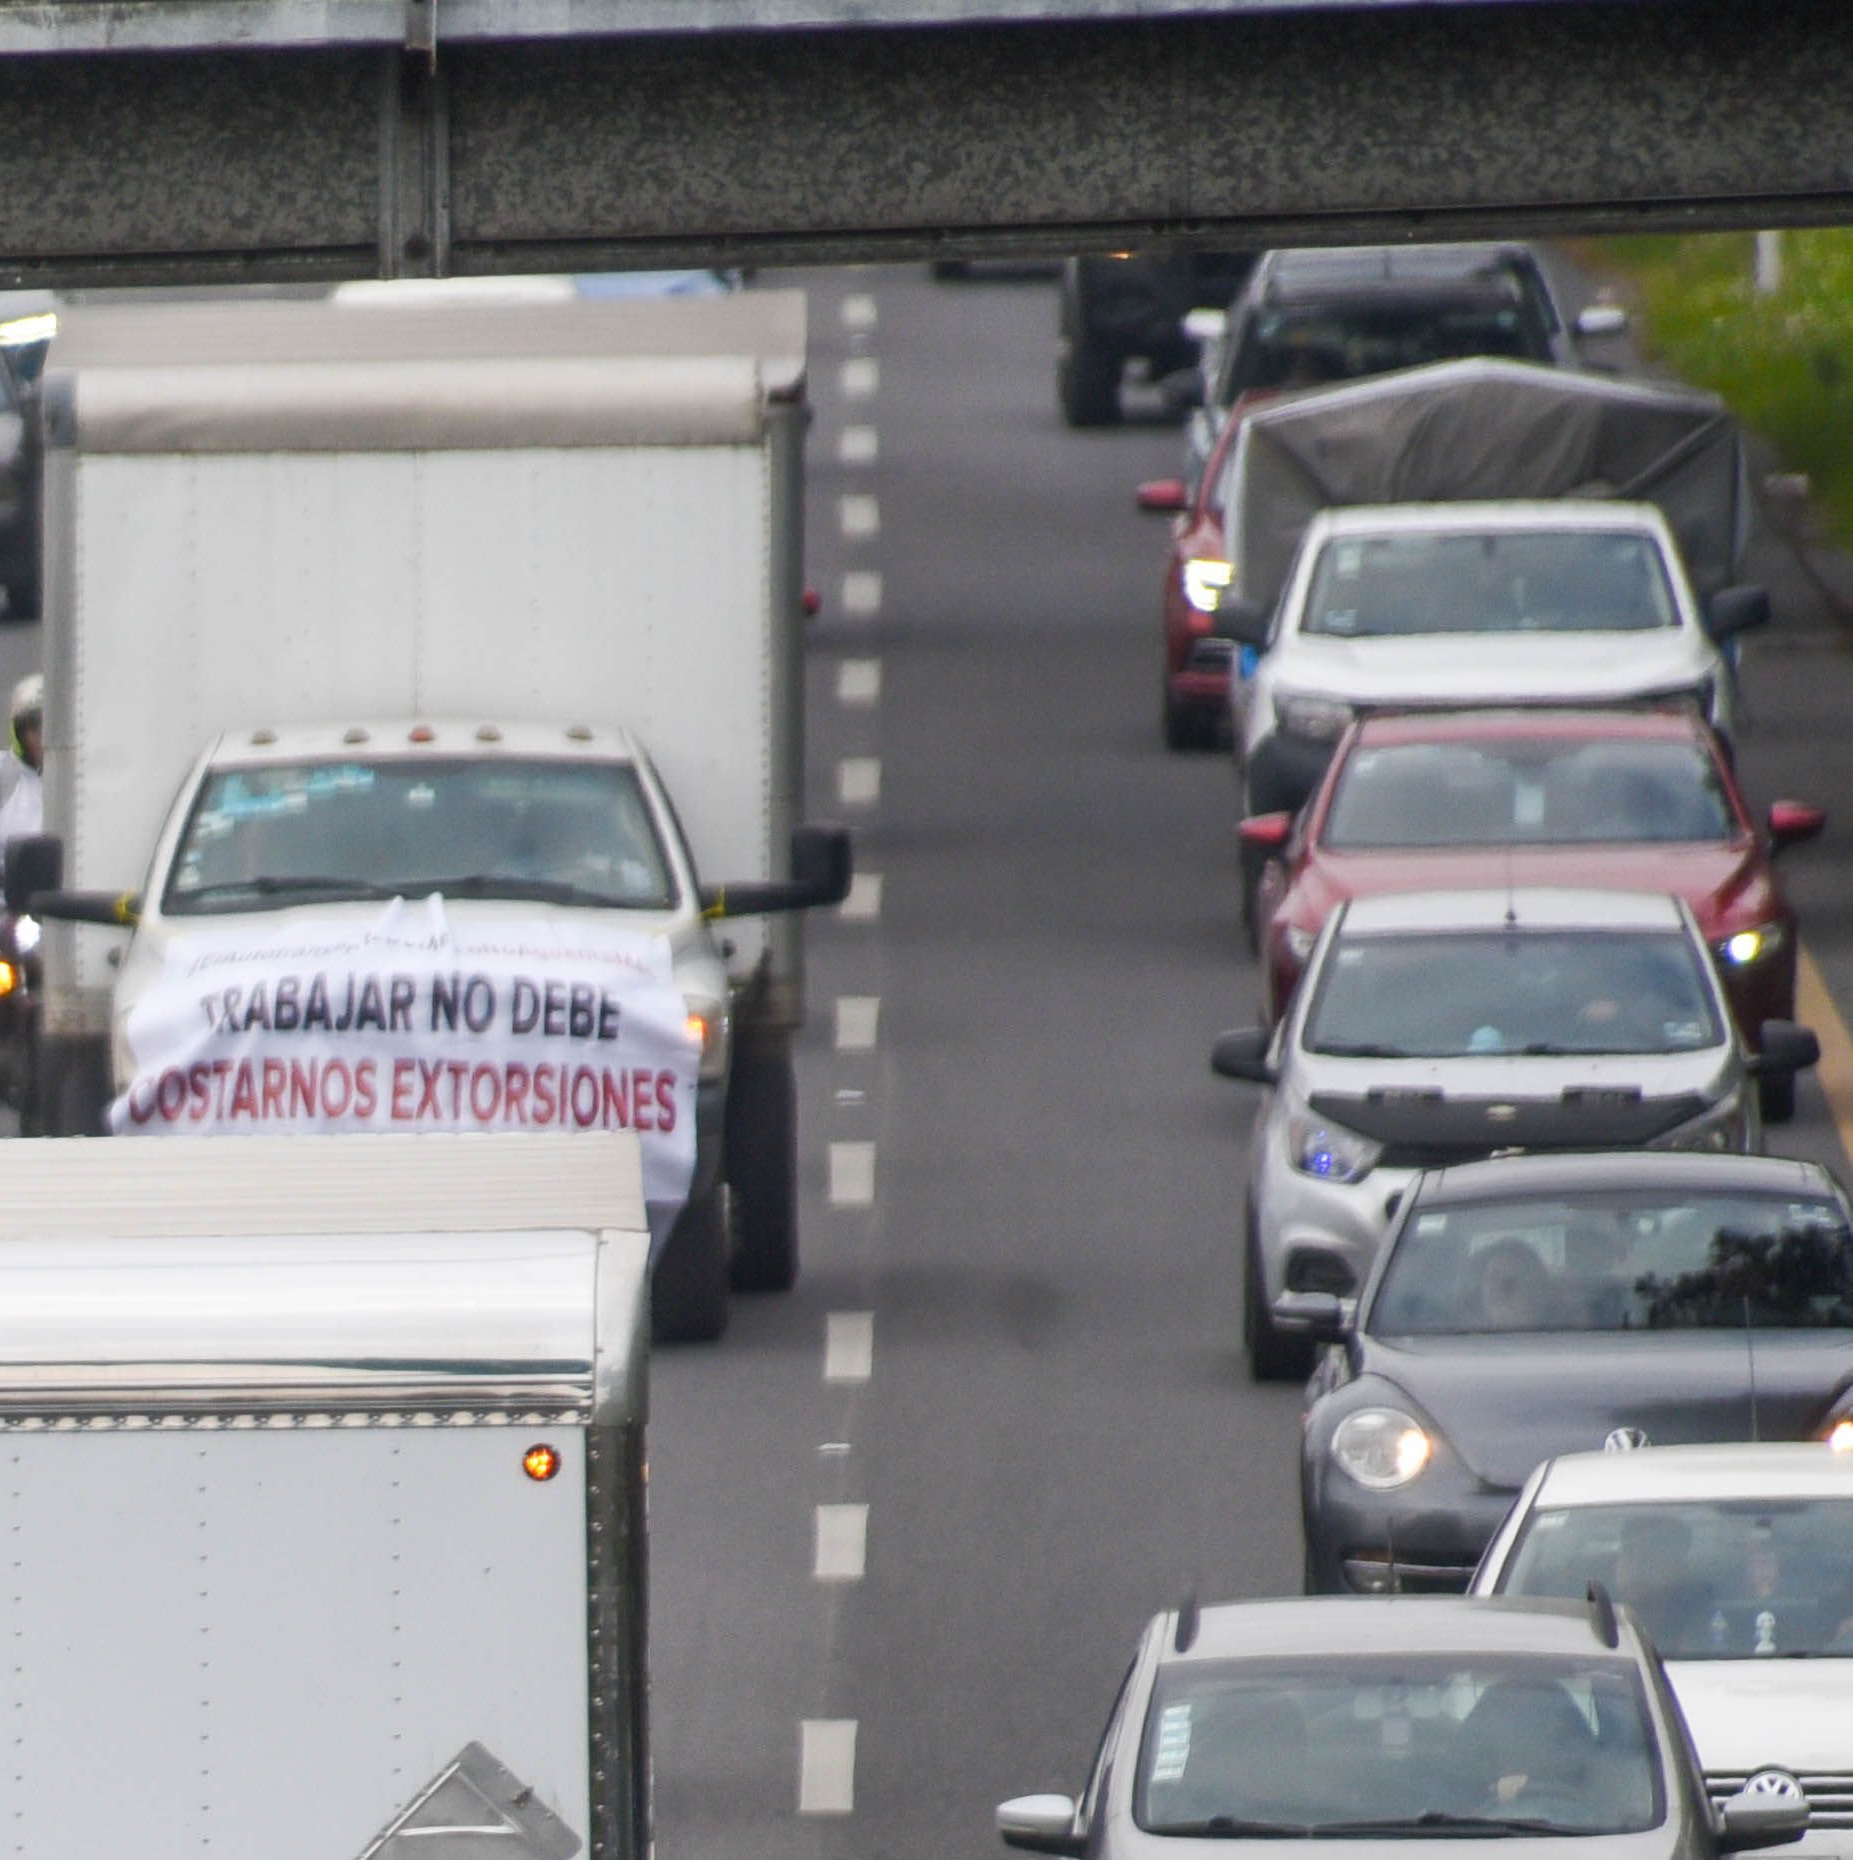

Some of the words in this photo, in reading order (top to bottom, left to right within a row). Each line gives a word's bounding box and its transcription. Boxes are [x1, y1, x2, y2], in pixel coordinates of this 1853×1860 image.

[201, 973, 415, 1035] TRABAJAR
[430, 972, 494, 1034] NO
[512, 976, 620, 1041] DEBE
[130, 1058, 378, 1126] COSTARNOS
[391, 1058, 677, 1134] EXTORSIONES
